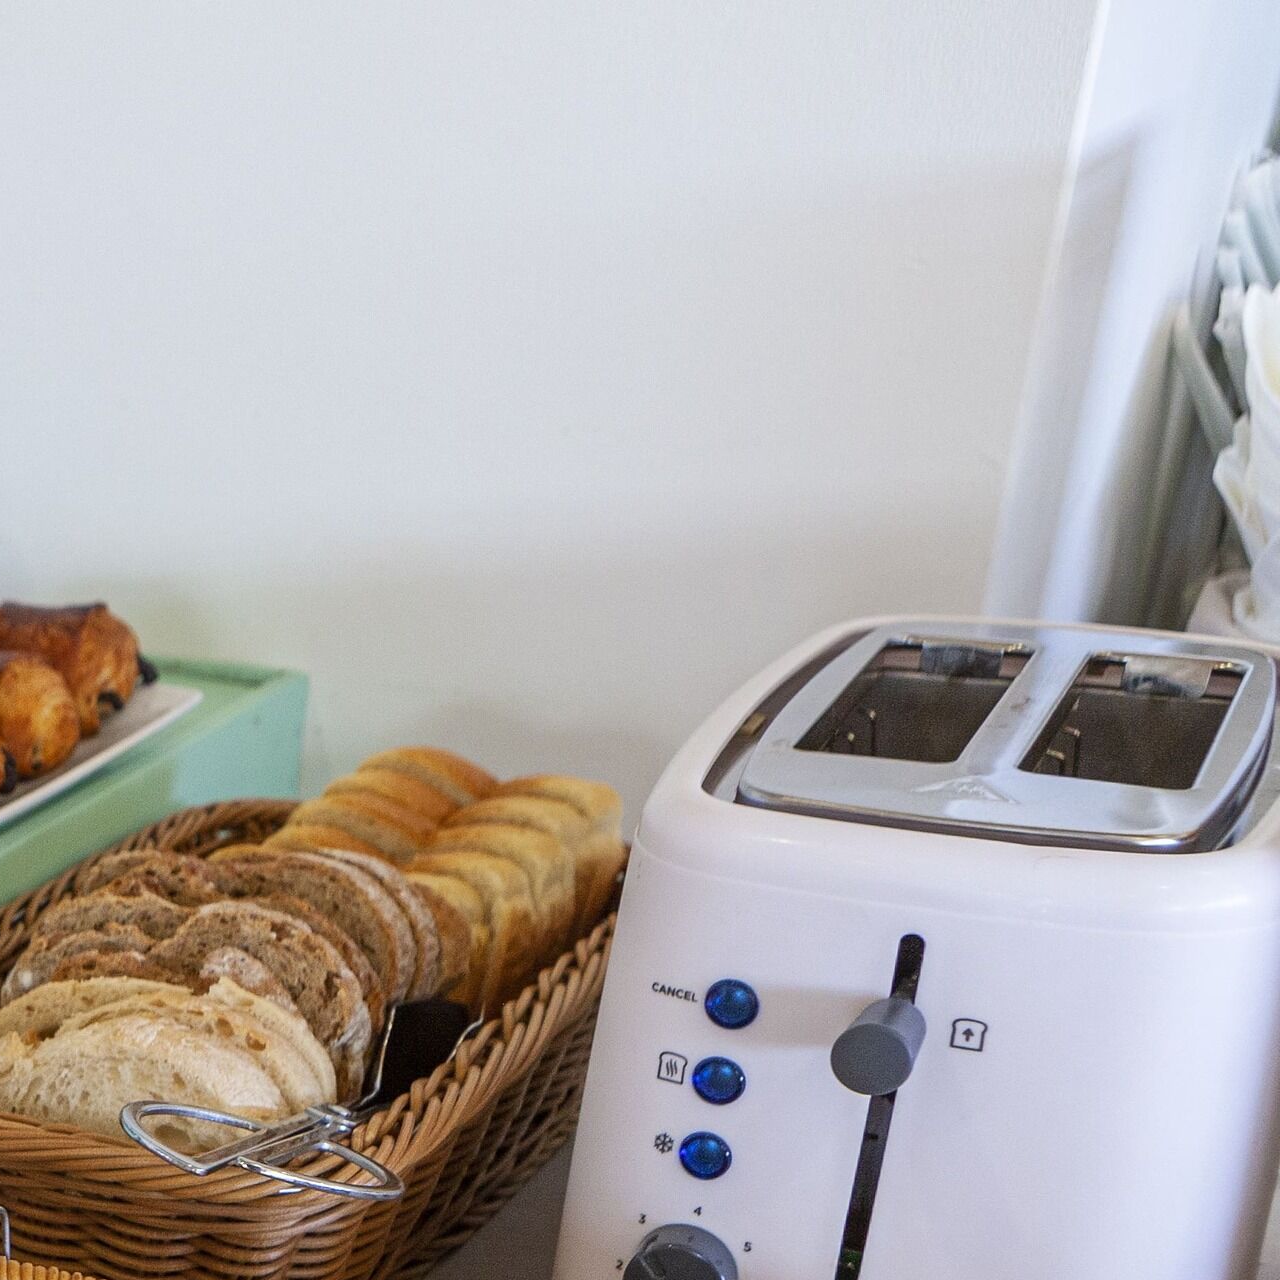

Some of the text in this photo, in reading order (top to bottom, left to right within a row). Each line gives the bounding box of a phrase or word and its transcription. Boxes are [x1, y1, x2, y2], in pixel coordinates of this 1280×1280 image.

[652, 982, 698, 1002] CANCEL
[693, 1206, 702, 1216] 4
[638, 1213, 647, 1224] 3
[743, 1241, 752, 1252] 5
[615, 1259, 624, 1270] 2
